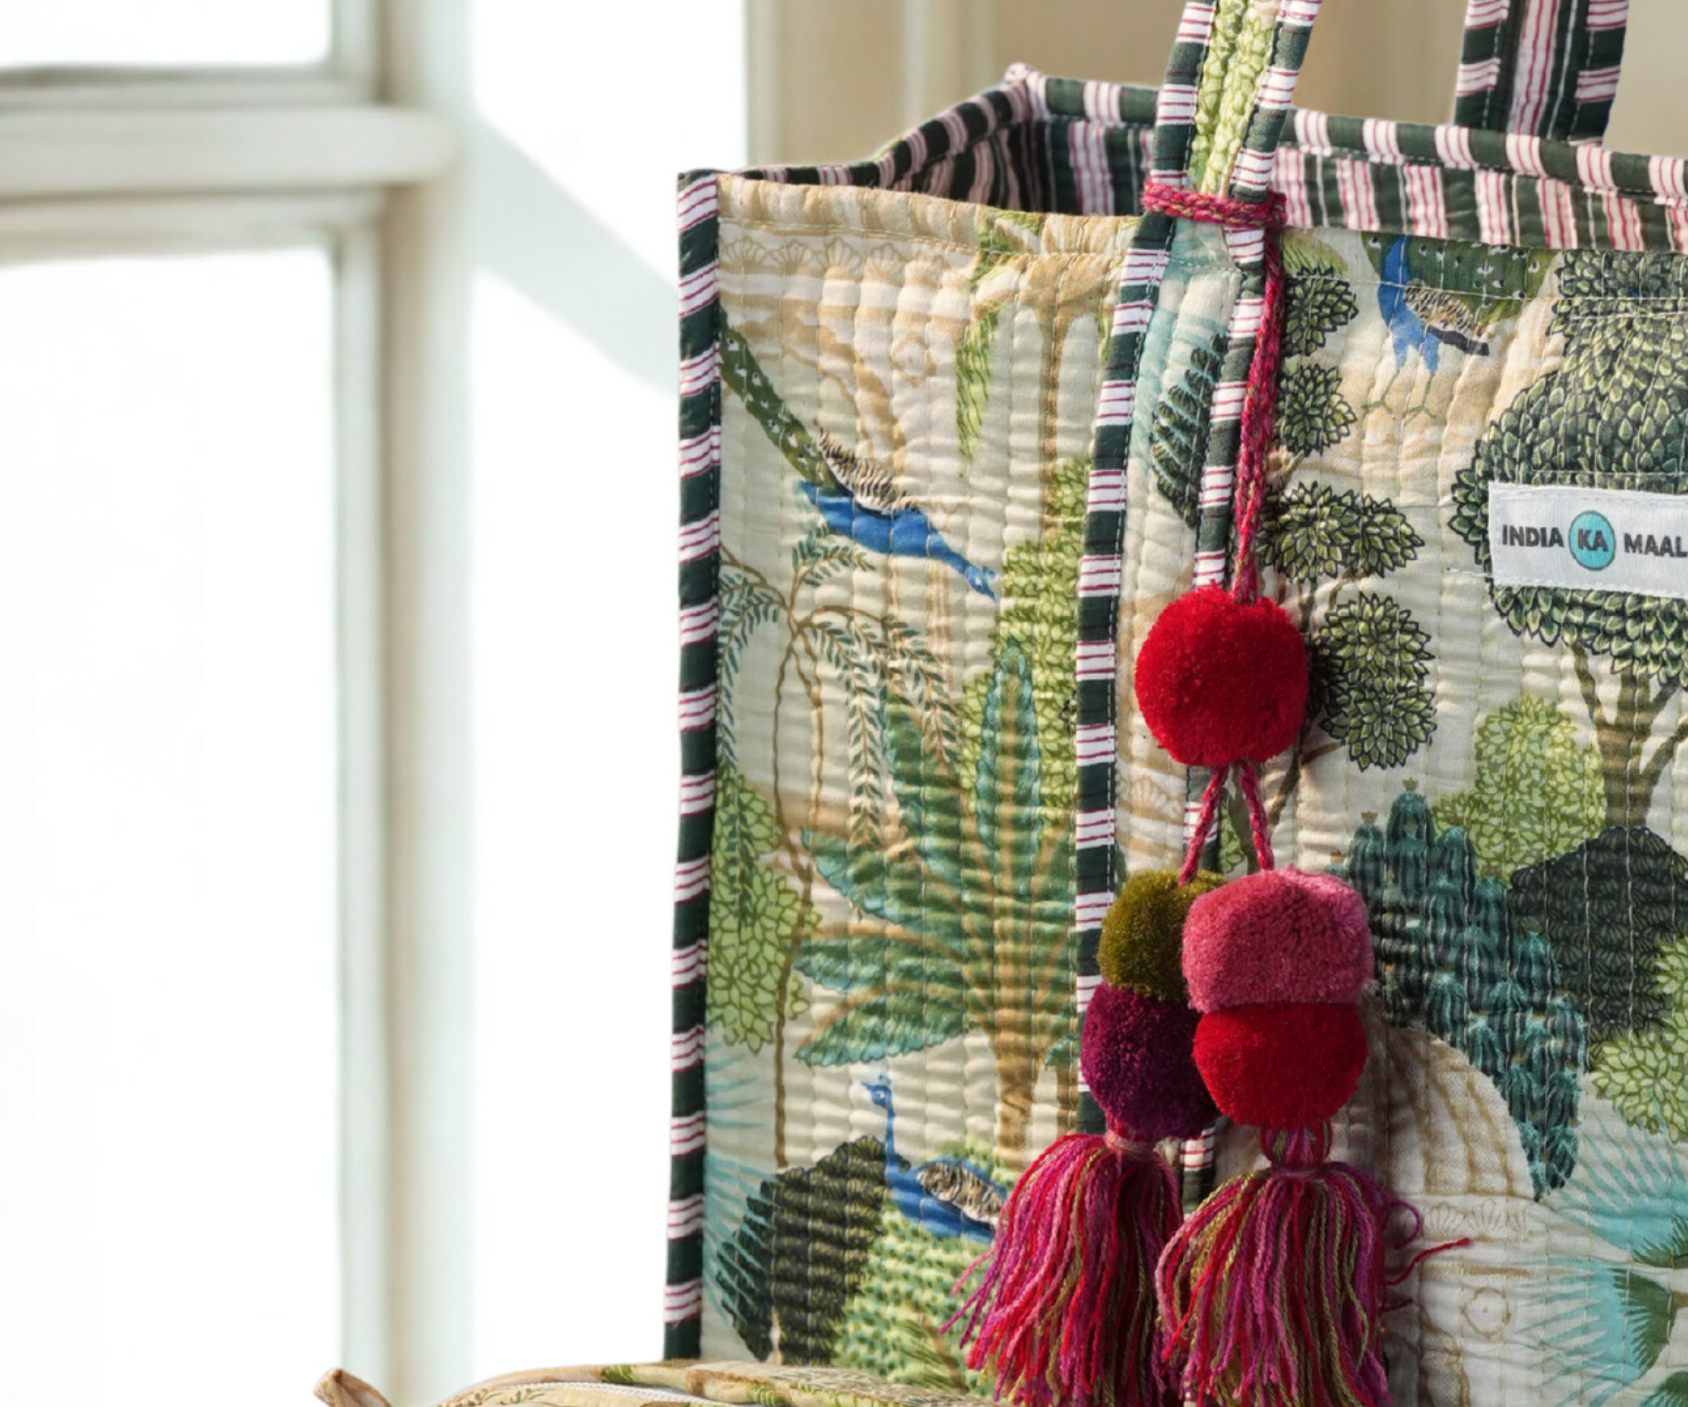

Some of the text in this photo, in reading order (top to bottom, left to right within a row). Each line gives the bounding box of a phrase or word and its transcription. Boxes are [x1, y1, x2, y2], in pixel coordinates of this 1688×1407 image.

[1502, 525, 1688, 558] INDIA KA MAAL
